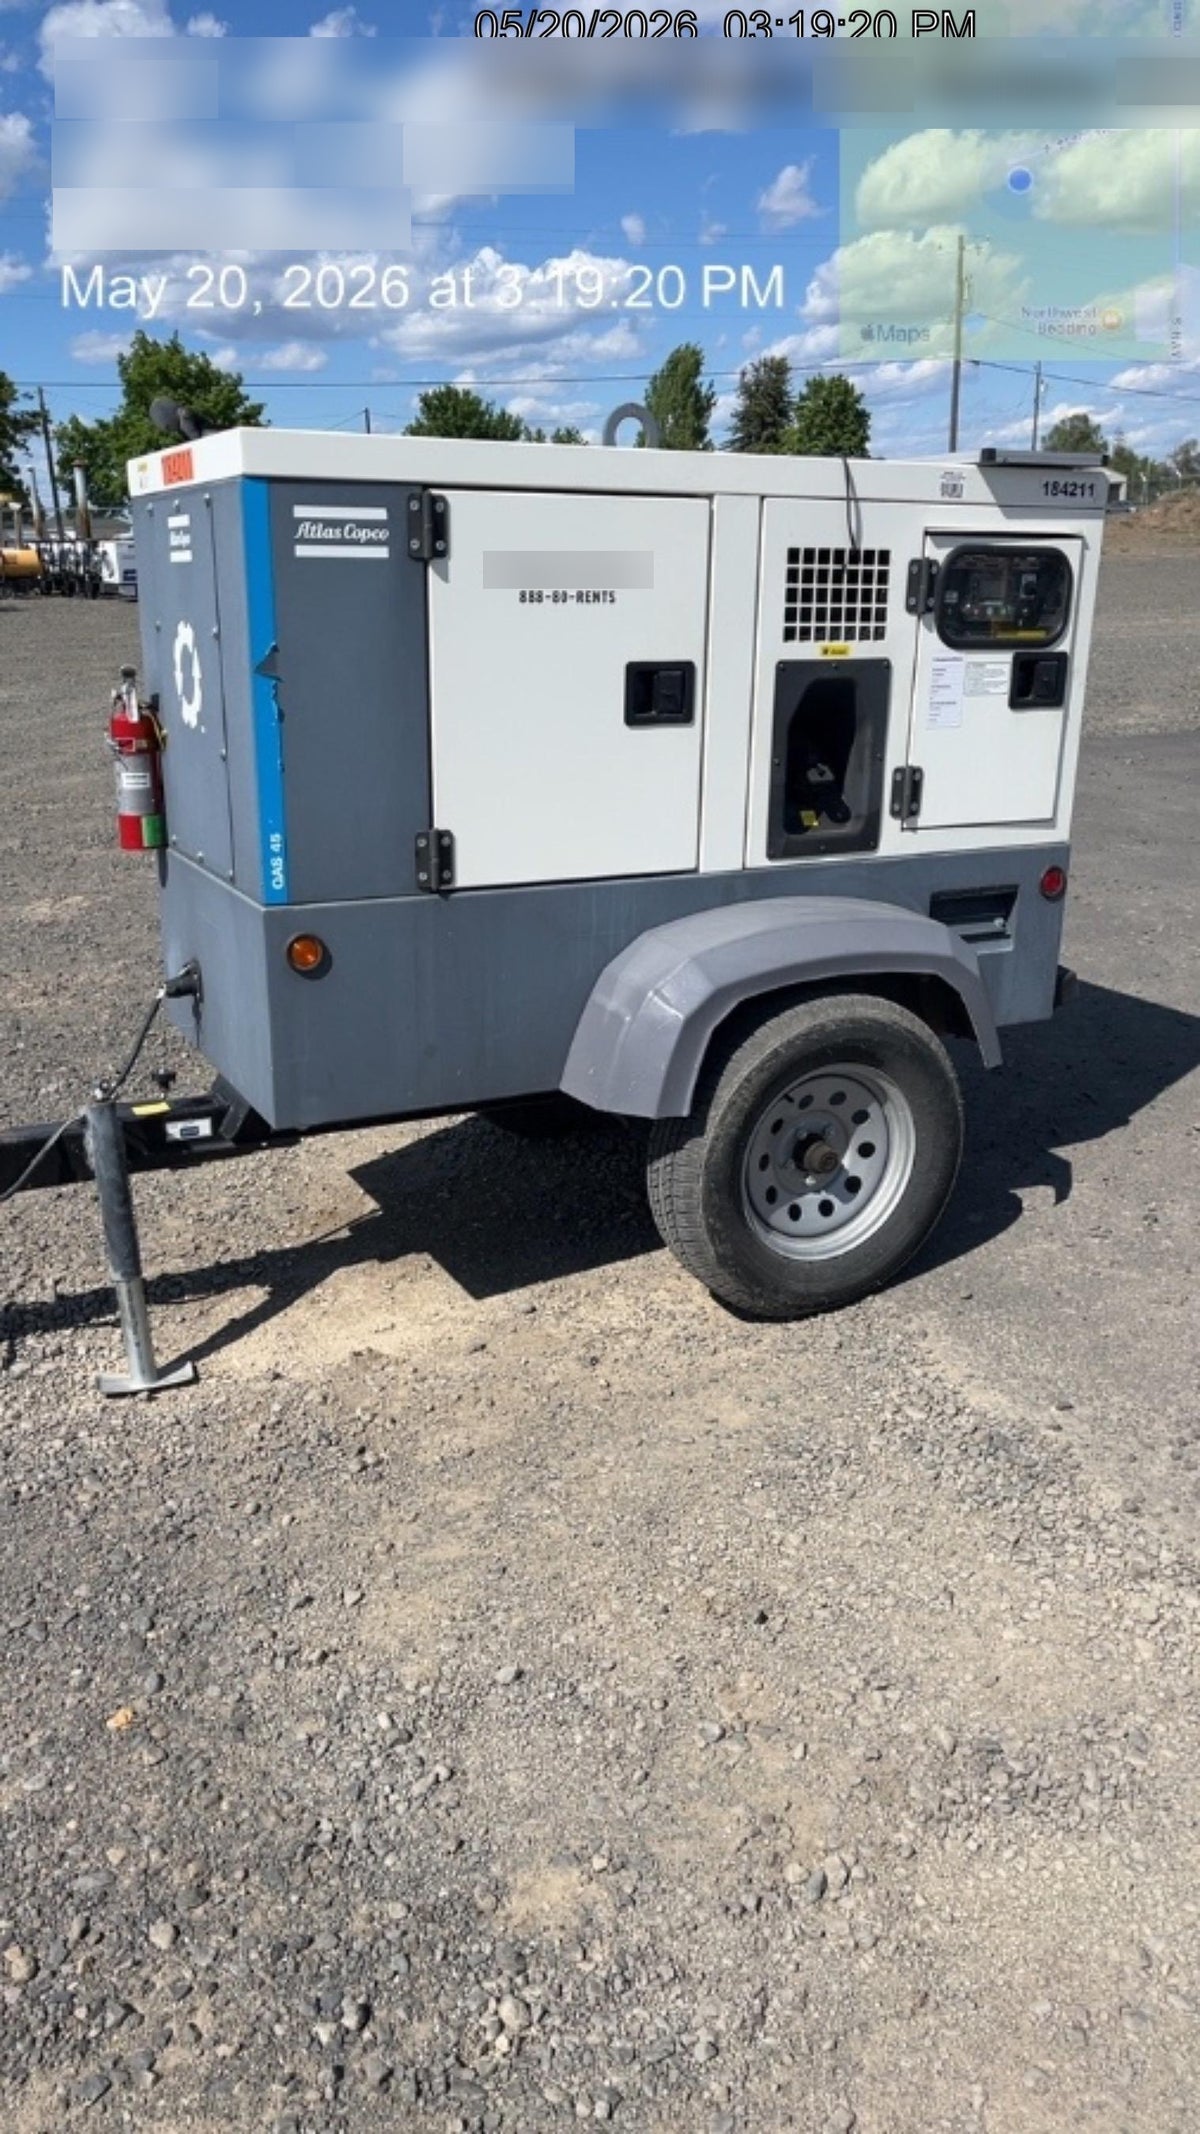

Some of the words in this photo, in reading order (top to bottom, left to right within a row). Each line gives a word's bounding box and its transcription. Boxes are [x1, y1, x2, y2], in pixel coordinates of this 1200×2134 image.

[1042, 480, 1095, 498] 184211
[293, 520, 342, 540] Atlas
[343, 522, 390, 544] Copco
[518, 589, 617, 604] 888-80-RENTS
